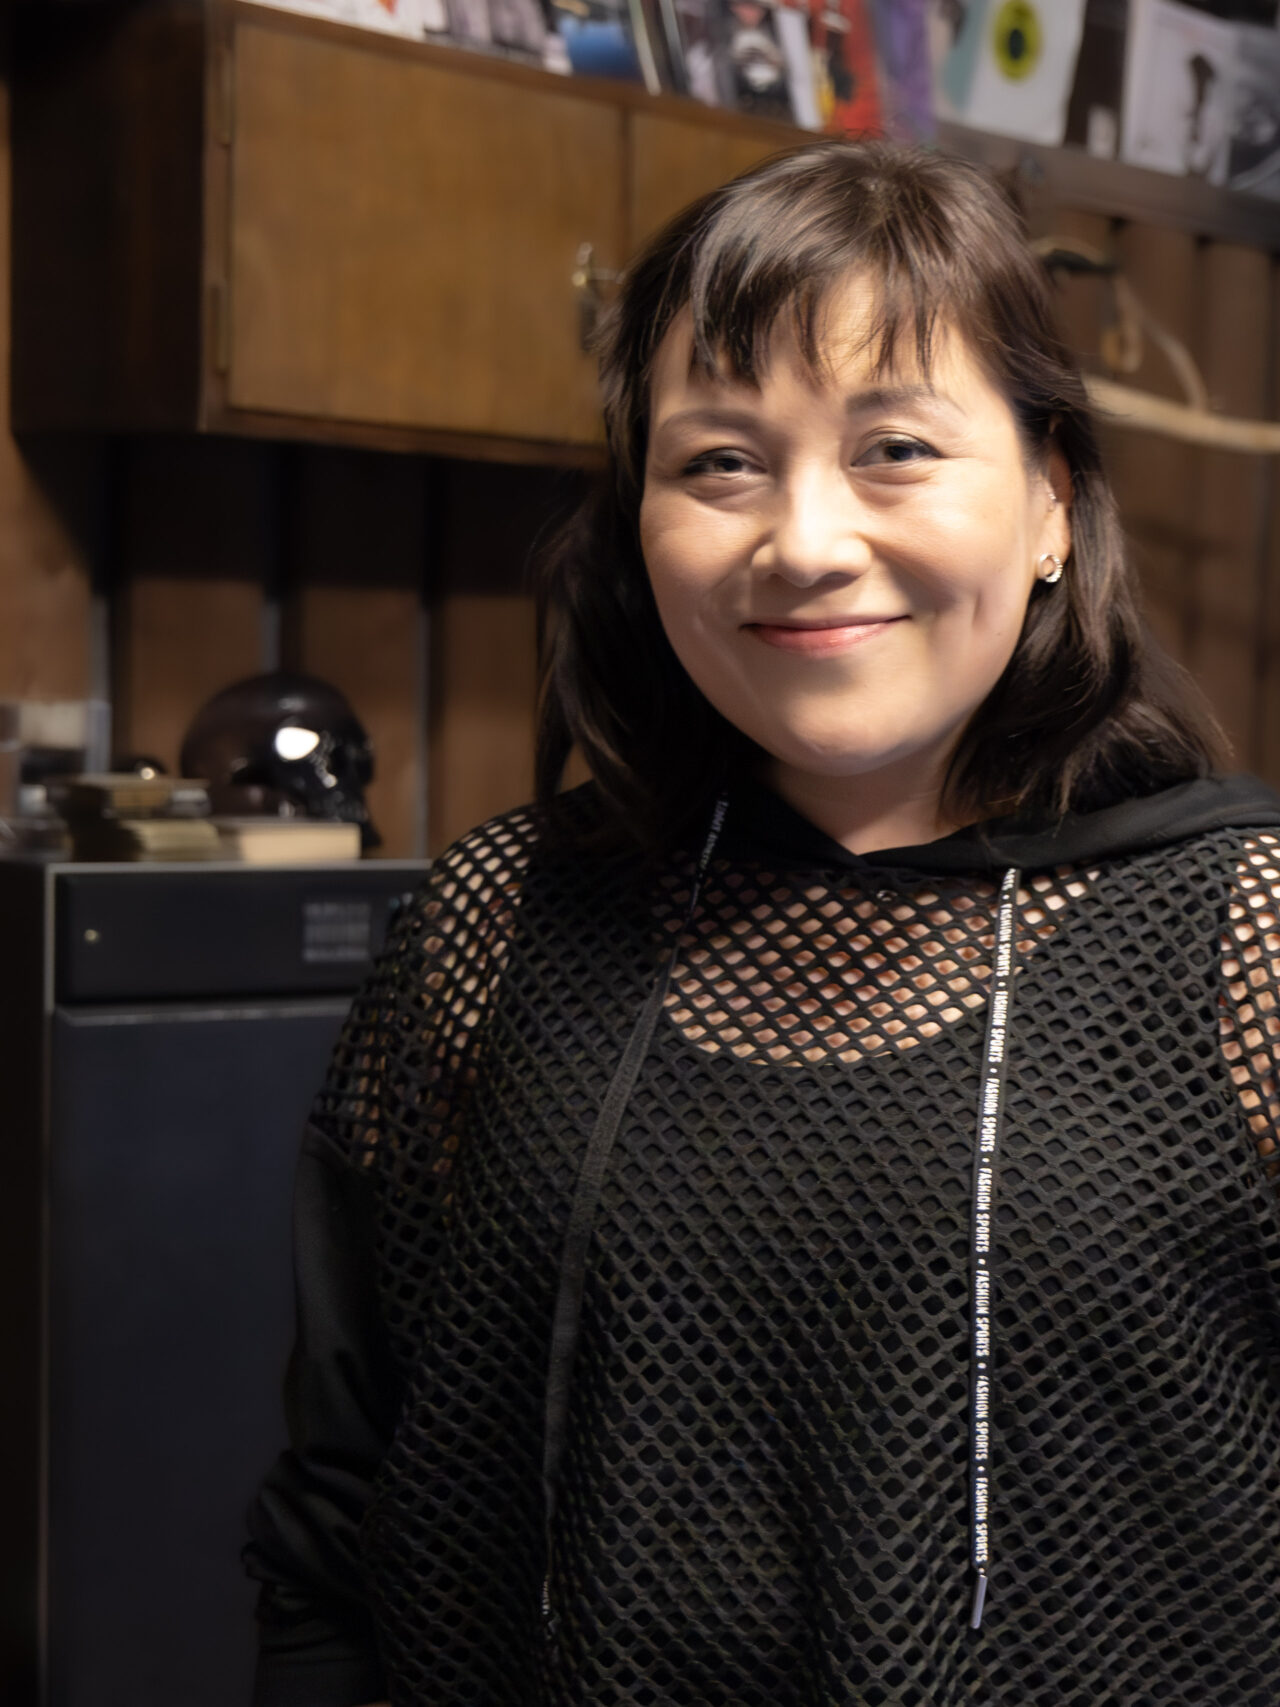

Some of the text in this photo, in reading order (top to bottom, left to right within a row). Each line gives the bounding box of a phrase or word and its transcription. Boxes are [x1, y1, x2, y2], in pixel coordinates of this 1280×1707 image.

[999, 903, 1013, 942] FASHION
[996, 943, 1012, 977] SPORTS
[992, 990, 1009, 1026] FASHION
[988, 1027, 1006, 1063] SPORTS
[983, 1078, 1000, 1115] FASHION
[980, 1116, 997, 1152] SPORTS
[976, 1167, 993, 1211] FASHION
[975, 1213, 991, 1253] SPORTS
[975, 1270, 990, 1314] FASHION
[975, 1317, 990, 1357] SPORTS
[975, 1375, 990, 1418] FASHION
[975, 1421, 989, 1460] SPORTS
[975, 1477, 989, 1520] FASHION
[975, 1523, 989, 1562] SPORTS
